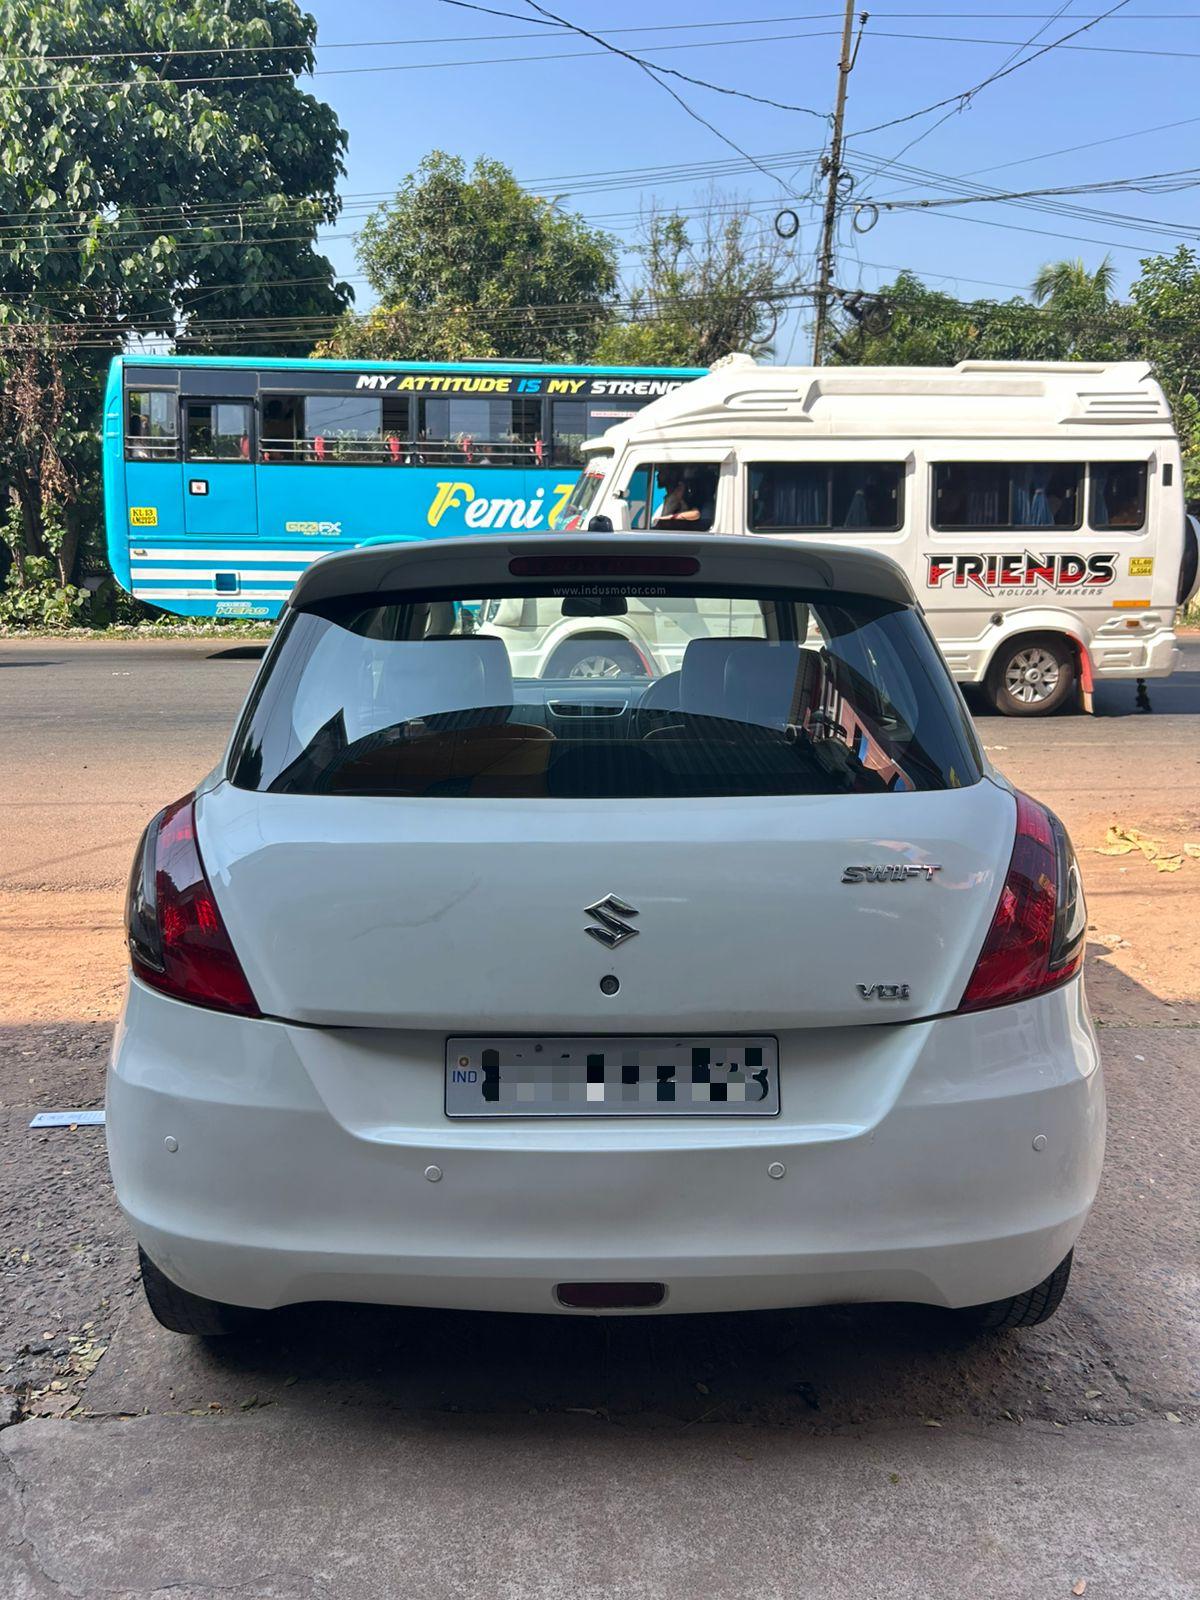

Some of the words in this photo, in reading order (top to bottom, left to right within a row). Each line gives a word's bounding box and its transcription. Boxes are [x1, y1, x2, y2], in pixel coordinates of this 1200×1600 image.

[356, 375, 396, 389] MY
[398, 377, 512, 392] ATTITUDE
[517, 379, 542, 393] IS
[547, 379, 586, 394] MY
[427, 482, 544, 529] Femi
[923, 550, 1120, 596] FRIENDS
[553, 585, 666, 595] www.indusmotor.com
[998, 589, 1048, 597] HOLIDAY
[1056, 588, 1104, 596] MAKERS
[841, 864, 942, 884] SWIFT
[452, 1070, 477, 1083] IND
